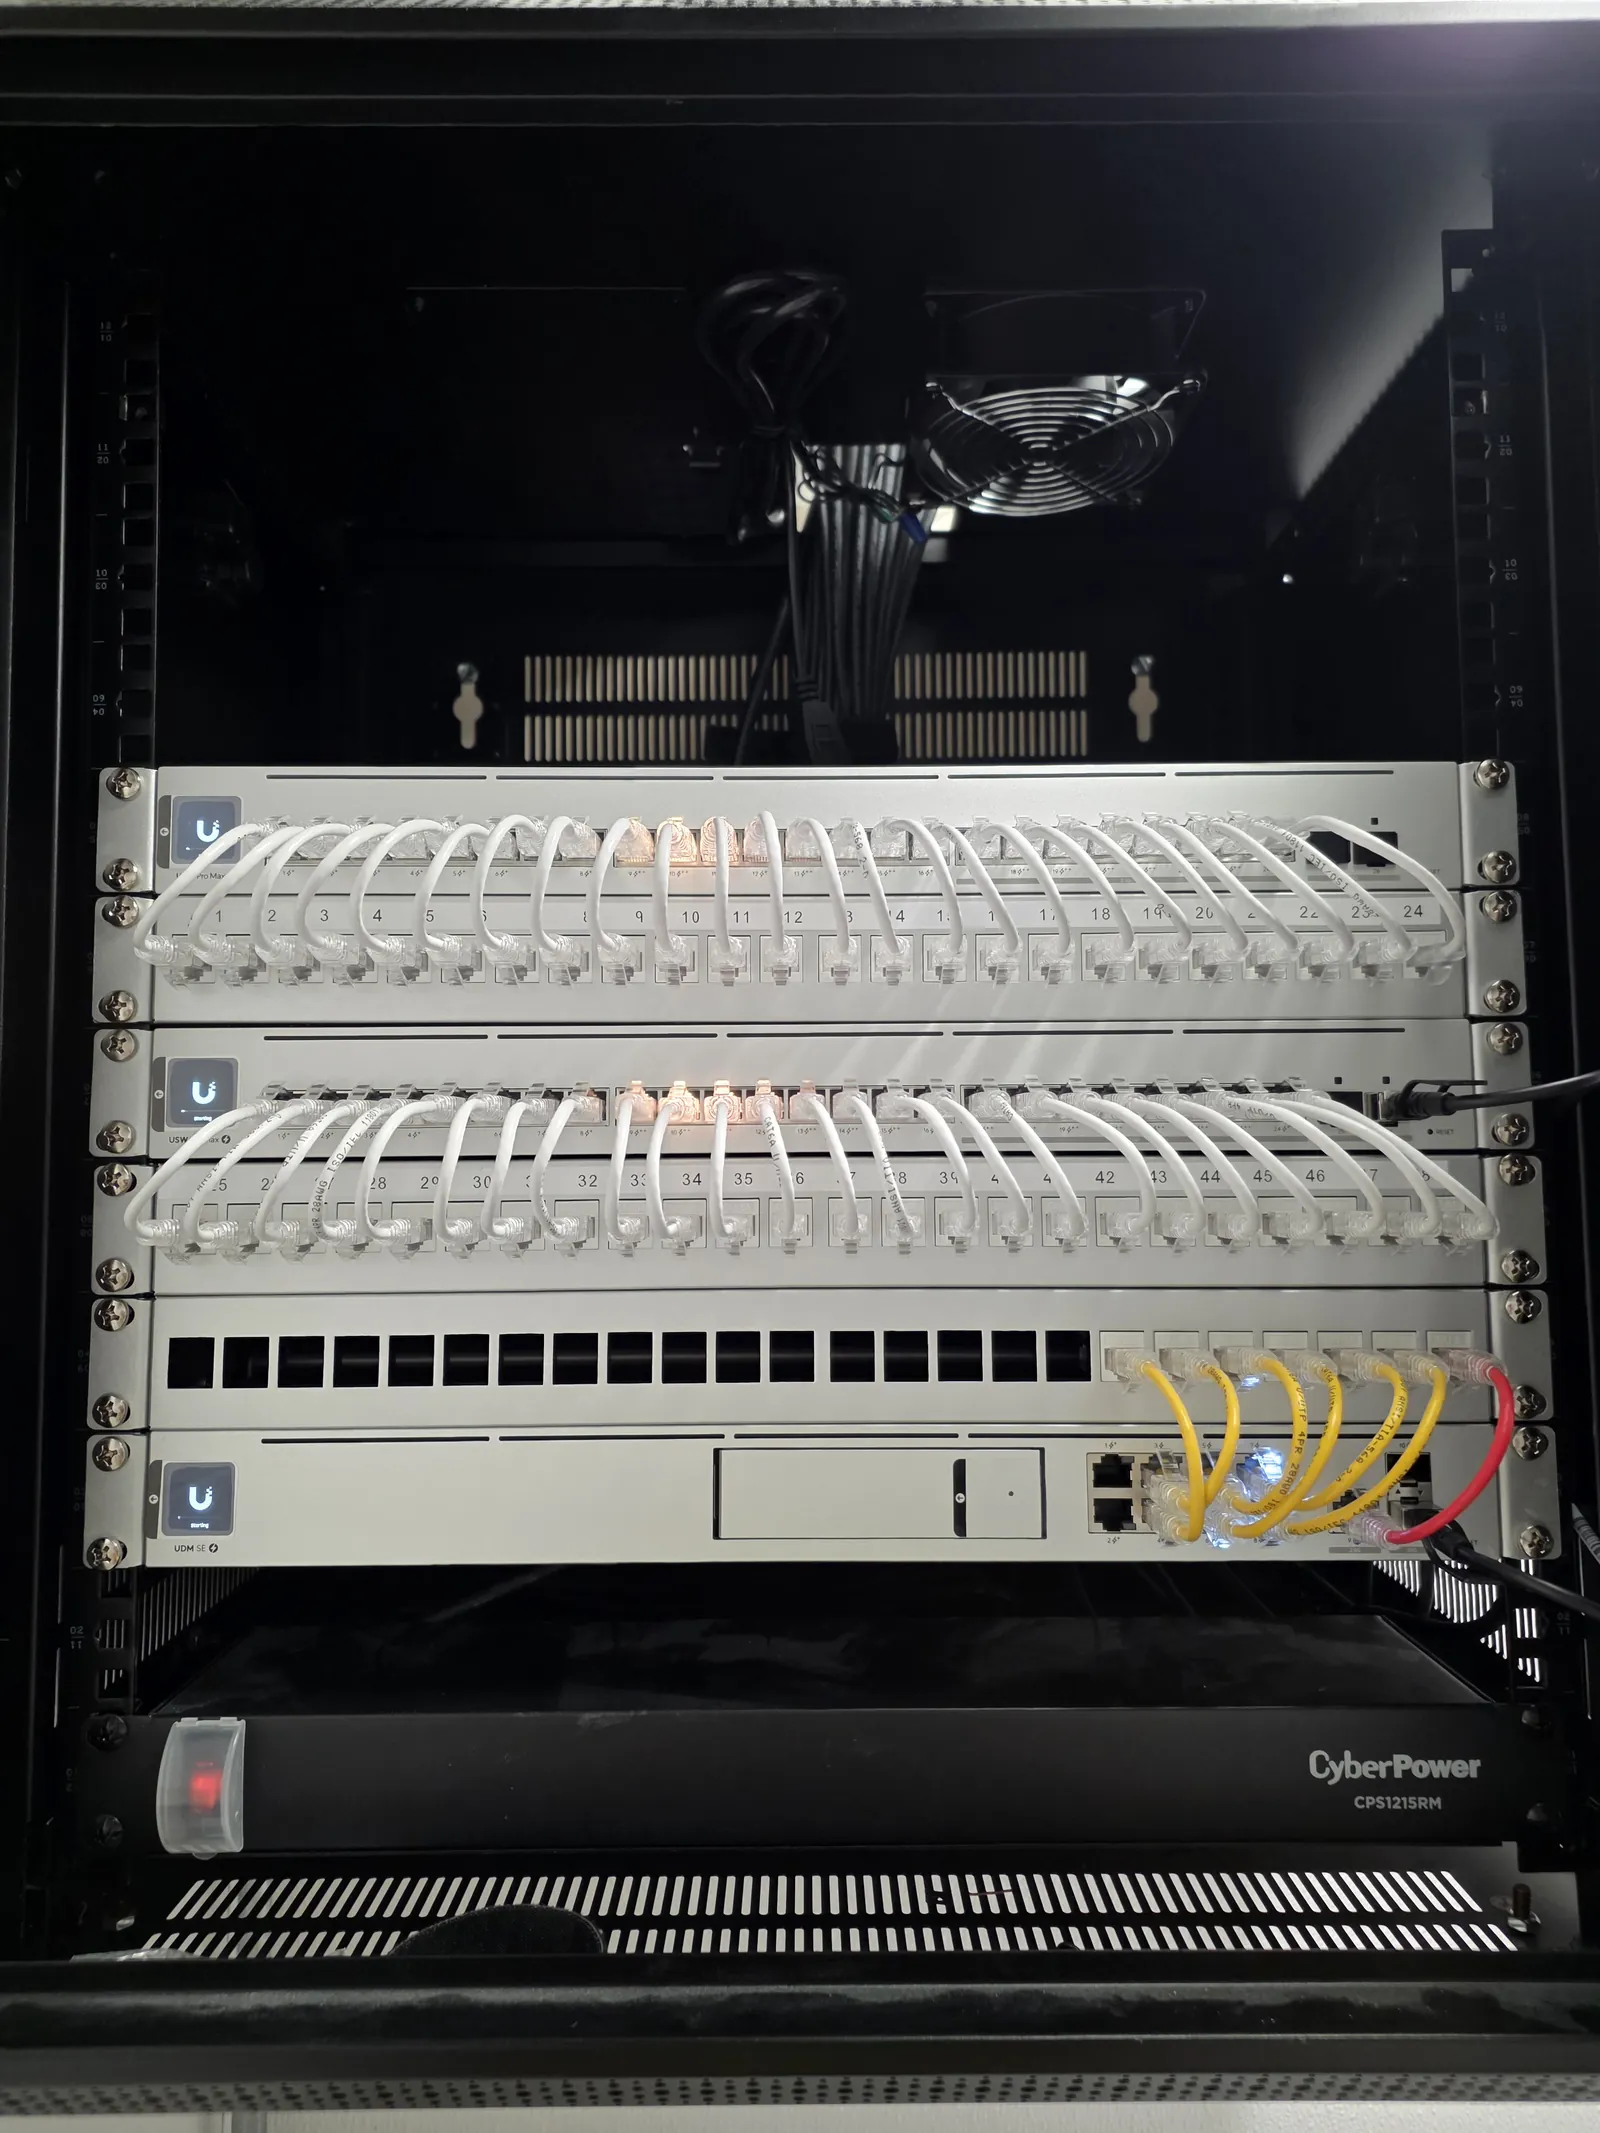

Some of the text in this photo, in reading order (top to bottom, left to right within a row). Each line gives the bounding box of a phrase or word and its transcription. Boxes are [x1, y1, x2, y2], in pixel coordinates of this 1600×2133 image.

[1308, 854, 1348, 890] ISO/IEC
[215, 910, 222, 922] 1
[267, 910, 276, 922] 2
[320, 910, 329, 922] 3
[372, 910, 382, 922] 4
[426, 910, 434, 922] 5
[635, 911, 643, 923] 9
[682, 911, 700, 923] 10
[733, 911, 749, 923] 11
[784, 911, 803, 923] 12
[846, 910, 853, 922] 3
[937, 910, 949, 922] 1
[1091, 908, 1110, 920] 18
[1143, 908, 1162, 920] 19
[1403, 905, 1423, 917] 24
[763, 1117, 776, 1147] CAT6A
[212, 1179, 227, 1192] 5
[473, 1176, 491, 1189] 30
[578, 1174, 598, 1187] 32
[682, 1173, 702, 1186] 34
[734, 1173, 753, 1186] 35
[795, 1172, 804, 1185] 6
[893, 1171, 907, 1184] 8
[1095, 1171, 1115, 1184] 42
[1150, 1171, 1167, 1184] 43
[1200, 1170, 1220, 1183] 44
[1253, 1170, 1272, 1183] 45
[1305, 1170, 1325, 1183] 46
[1369, 1169, 1378, 1182] 7
[1293, 1431, 1306, 1454] 4PR
[70, 1625, 84, 1635] 02
[1309, 1750, 1482, 1786] CyberPower
[1353, 1796, 1442, 1810] CPS1215RM
